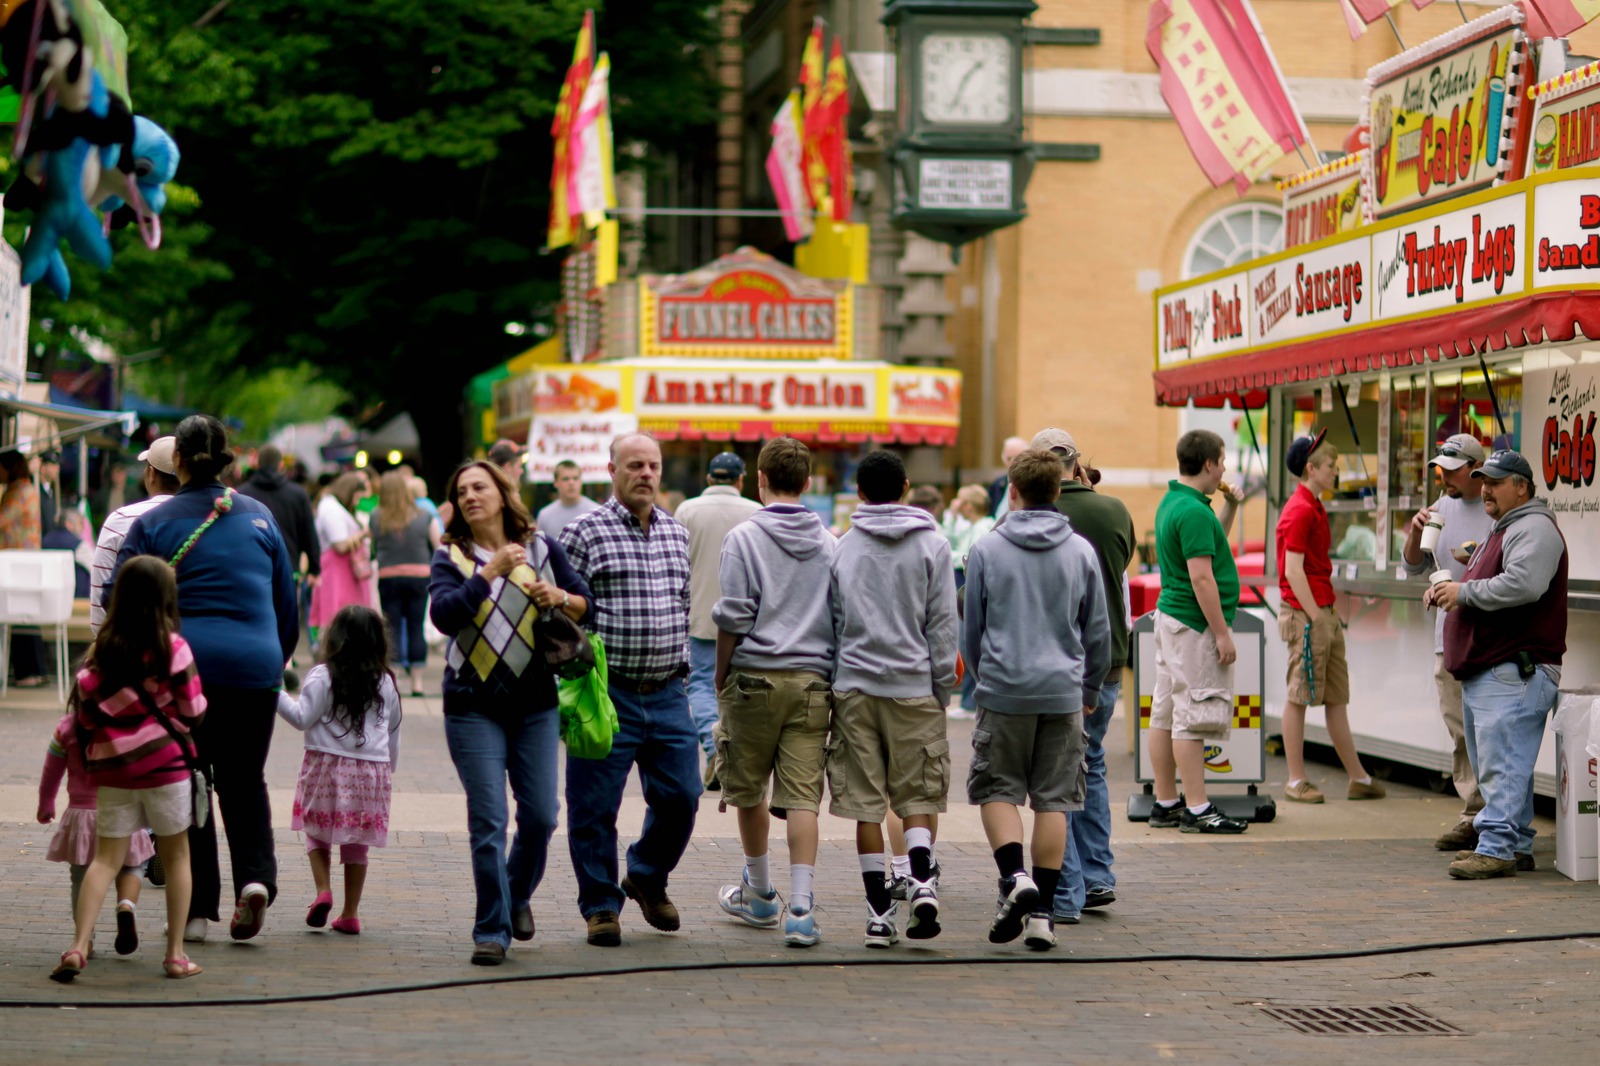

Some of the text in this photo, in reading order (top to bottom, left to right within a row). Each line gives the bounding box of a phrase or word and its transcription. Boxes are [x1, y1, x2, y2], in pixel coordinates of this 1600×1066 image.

[1417, 97, 1474, 196] Café
[1295, 262, 1363, 322] Sausage
[1378, 214, 1516, 316] Jumbo Turkey Legs
[662, 302, 833, 340] FUNNEL CAKES
[643, 372, 774, 411] Amazing
[784, 376, 865, 407] Onion
[1549, 367, 1571, 406] Little
[1560, 376, 1596, 427] Richard's
[1542, 411, 1597, 491] Café
